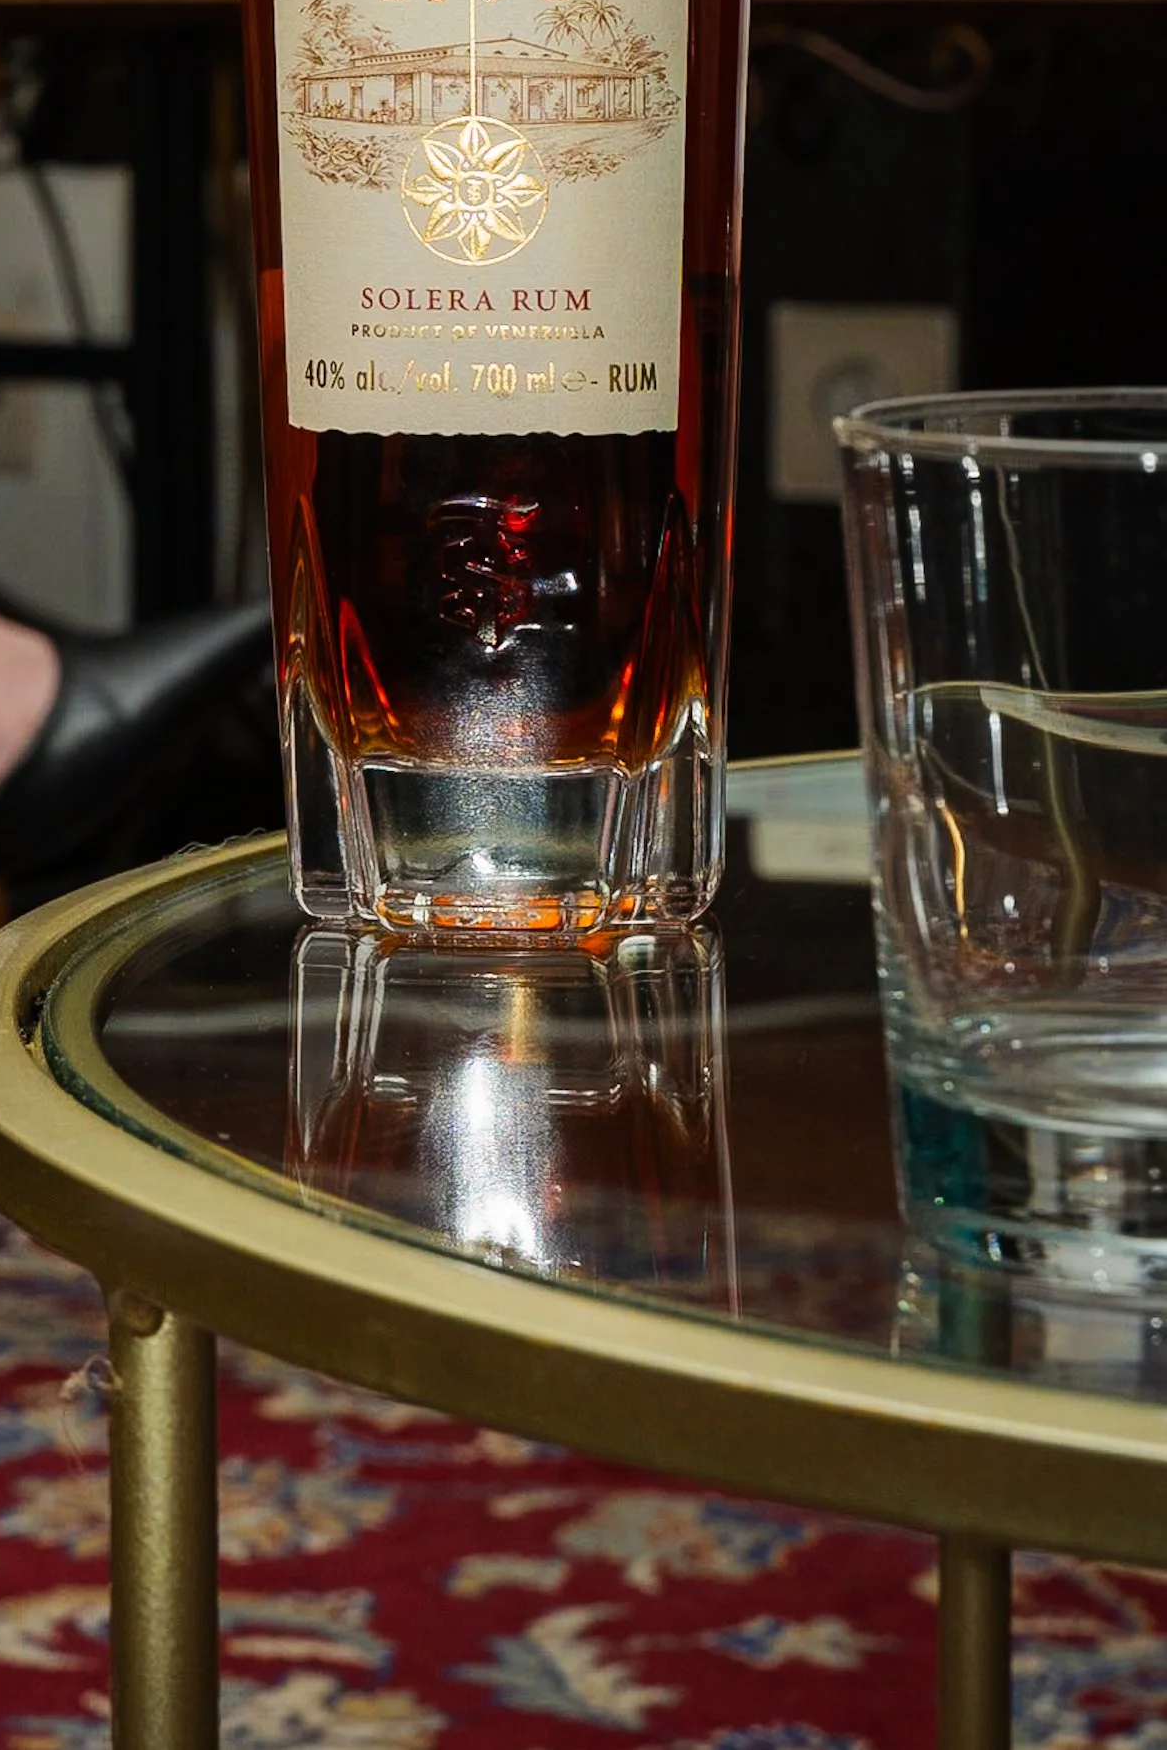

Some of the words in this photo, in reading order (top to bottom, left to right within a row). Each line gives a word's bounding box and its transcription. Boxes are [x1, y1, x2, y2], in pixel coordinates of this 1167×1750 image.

[361, 286, 496, 312] SOLERA
[512, 288, 592, 312] RUM
[351, 323, 443, 339] PRODUCT
[451, 324, 477, 340] OF
[484, 324, 605, 340] VENEZUELA
[305, 358, 346, 390] 40%
[470, 363, 517, 398] 700
[525, 361, 555, 394] ml
[609, 362, 657, 392] RUM
